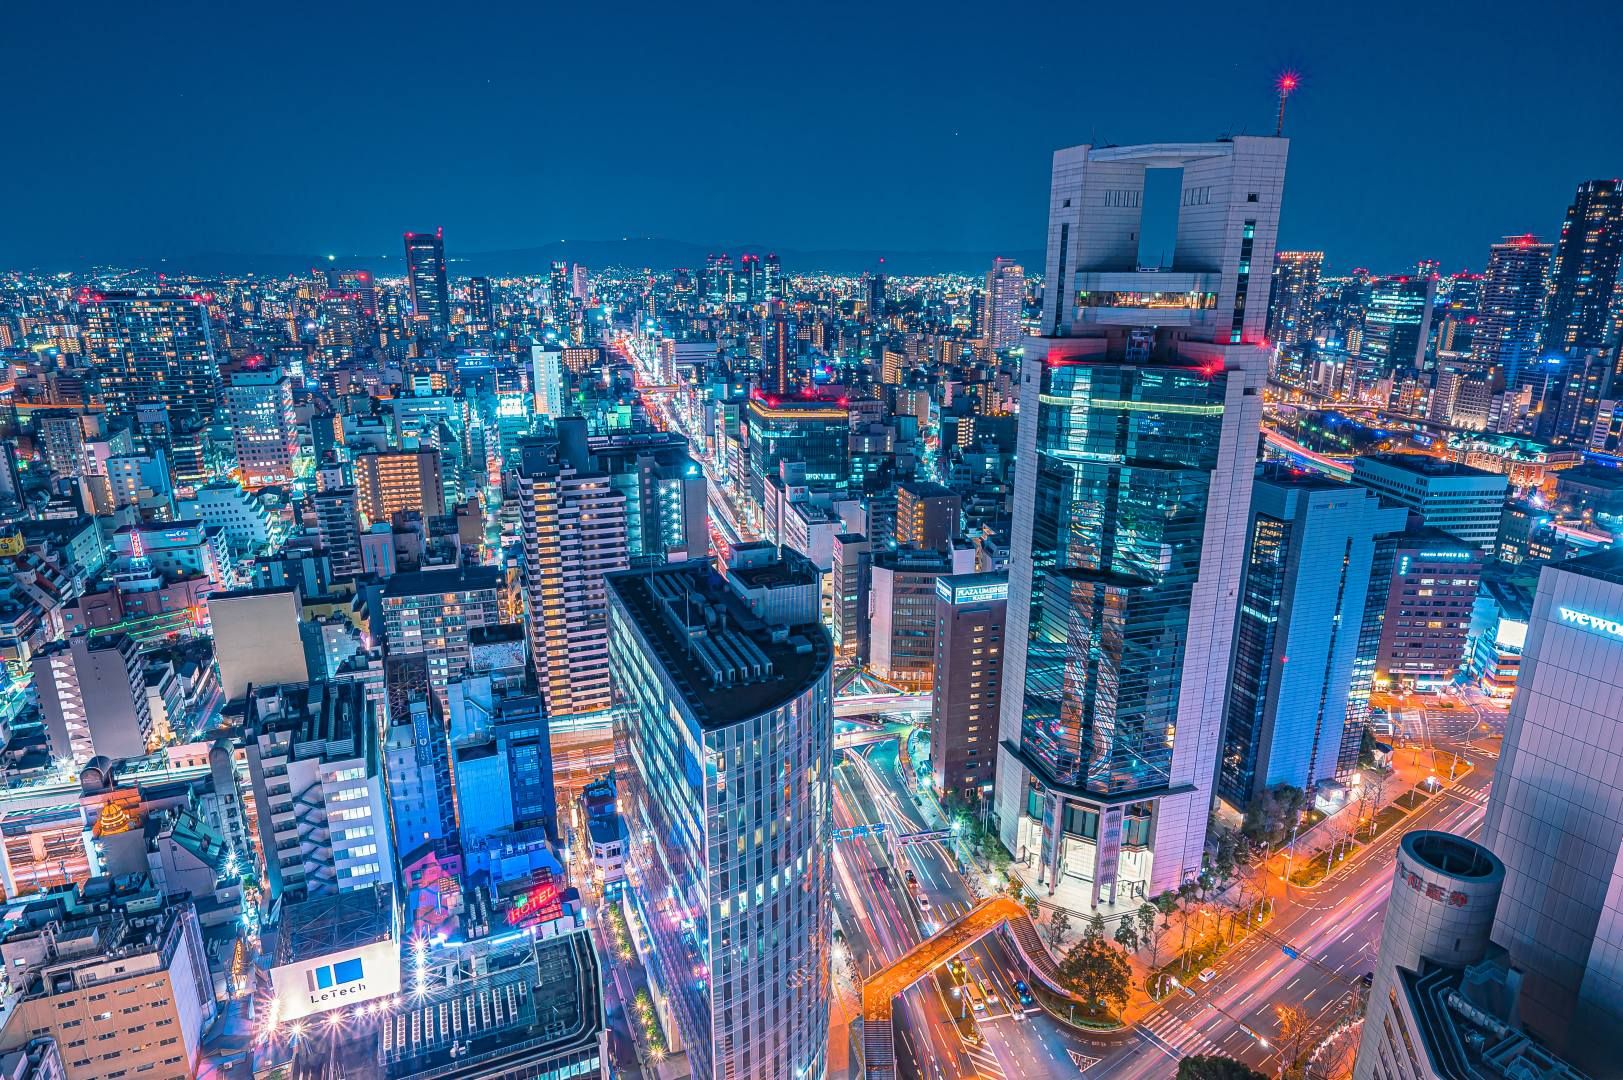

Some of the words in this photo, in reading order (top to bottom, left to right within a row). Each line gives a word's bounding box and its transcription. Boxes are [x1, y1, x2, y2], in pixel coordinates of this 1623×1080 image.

[957, 587, 979, 597] PLAZA
[511, 885, 556, 921] HOTEL
[310, 983, 366, 1004] LeTech
